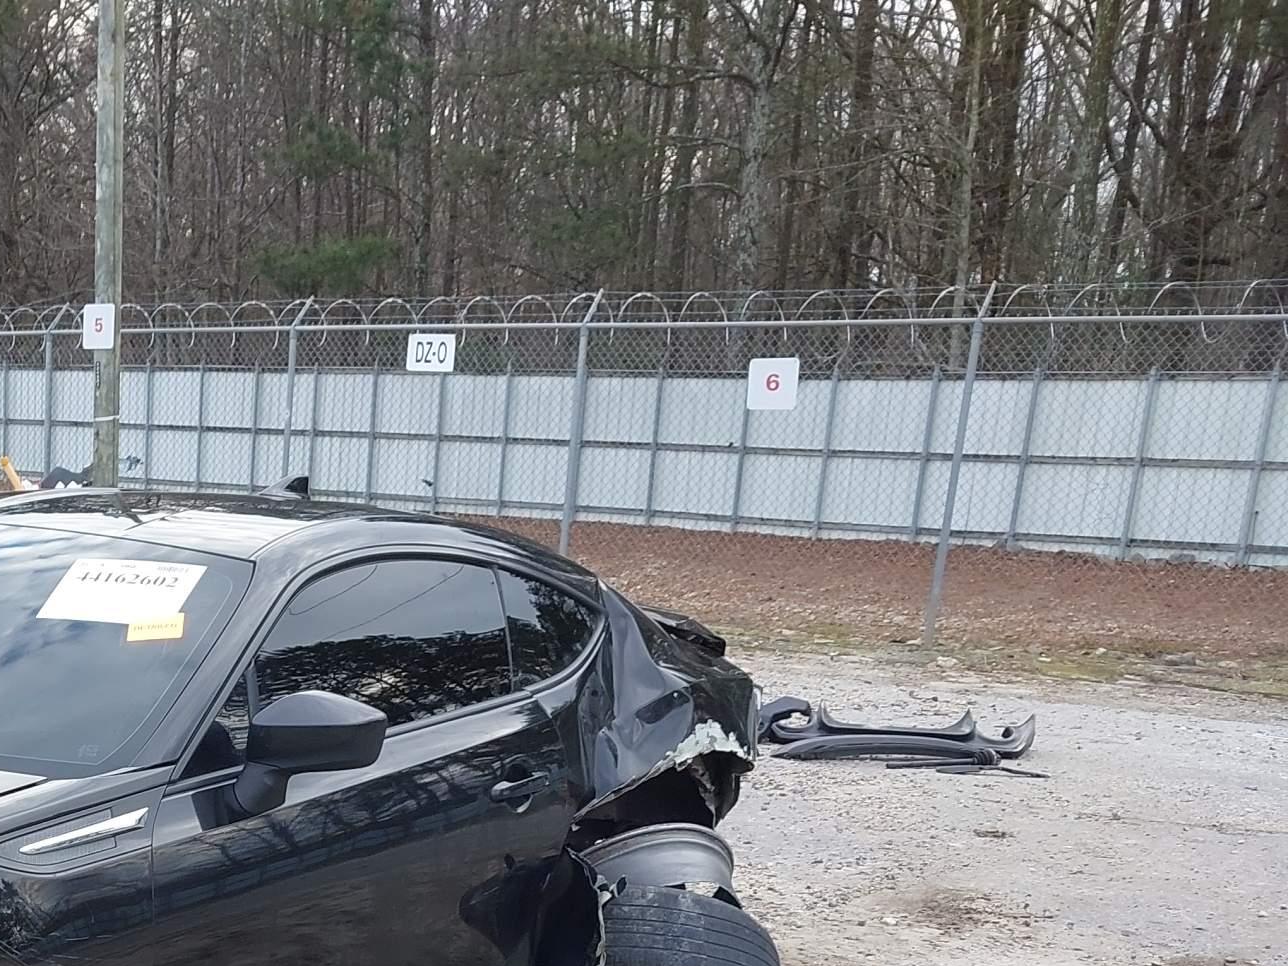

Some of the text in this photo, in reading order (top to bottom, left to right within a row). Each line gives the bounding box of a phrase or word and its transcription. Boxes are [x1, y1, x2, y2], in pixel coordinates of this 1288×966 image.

[94, 317, 104, 333] 5
[766, 373, 780, 391] 6
[76, 571, 180, 588] 44162602
